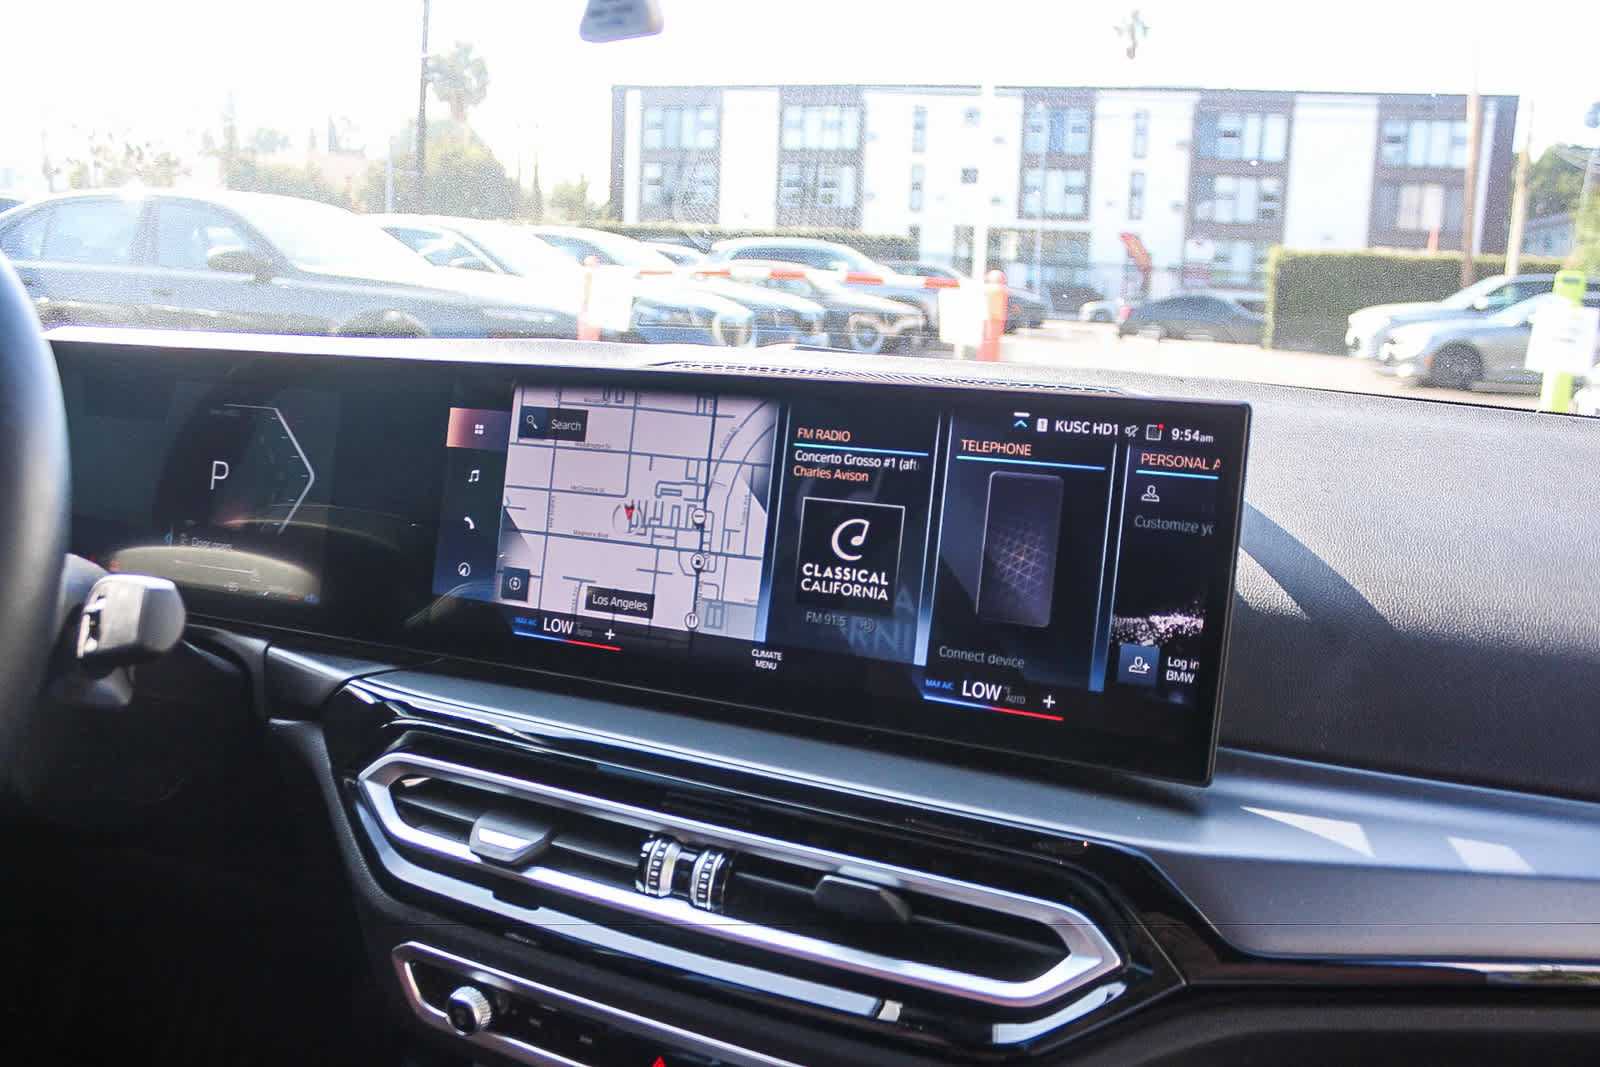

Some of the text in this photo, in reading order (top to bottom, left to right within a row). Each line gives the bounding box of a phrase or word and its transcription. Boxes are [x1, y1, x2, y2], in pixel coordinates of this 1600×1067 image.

[551, 418, 582, 432] Search
[1055, 419, 1119, 436] KUSC HD1
[797, 427, 851, 442] FM RADIO
[1171, 427, 1214, 443] 9:54am
[961, 439, 1032, 456] TELEPHONE
[794, 449, 842, 466] Concerto
[843, 454, 882, 468] Grosso
[883, 456, 896, 469] #1
[1141, 452, 1209, 471] PERSONAL
[210, 460, 229, 491] P
[793, 465, 870, 482] Charles Avison
[1134, 514, 1199, 534] Customize
[802, 562, 889, 586] CLASSICAL
[800, 577, 889, 601] CALIFORNIA
[591, 592, 609, 606] Los
[611, 596, 648, 612] Angeles
[543, 617, 574, 635] LOW
[805, 611, 822, 625] FM
[751, 648, 783, 661] CLIMATE
[938, 645, 1025, 668] Connect device
[755, 659, 778, 671] MENU
[1167, 656, 1188, 671] Log
[1166, 670, 1195, 683] BMW
[961, 679, 1003, 701] LOW
